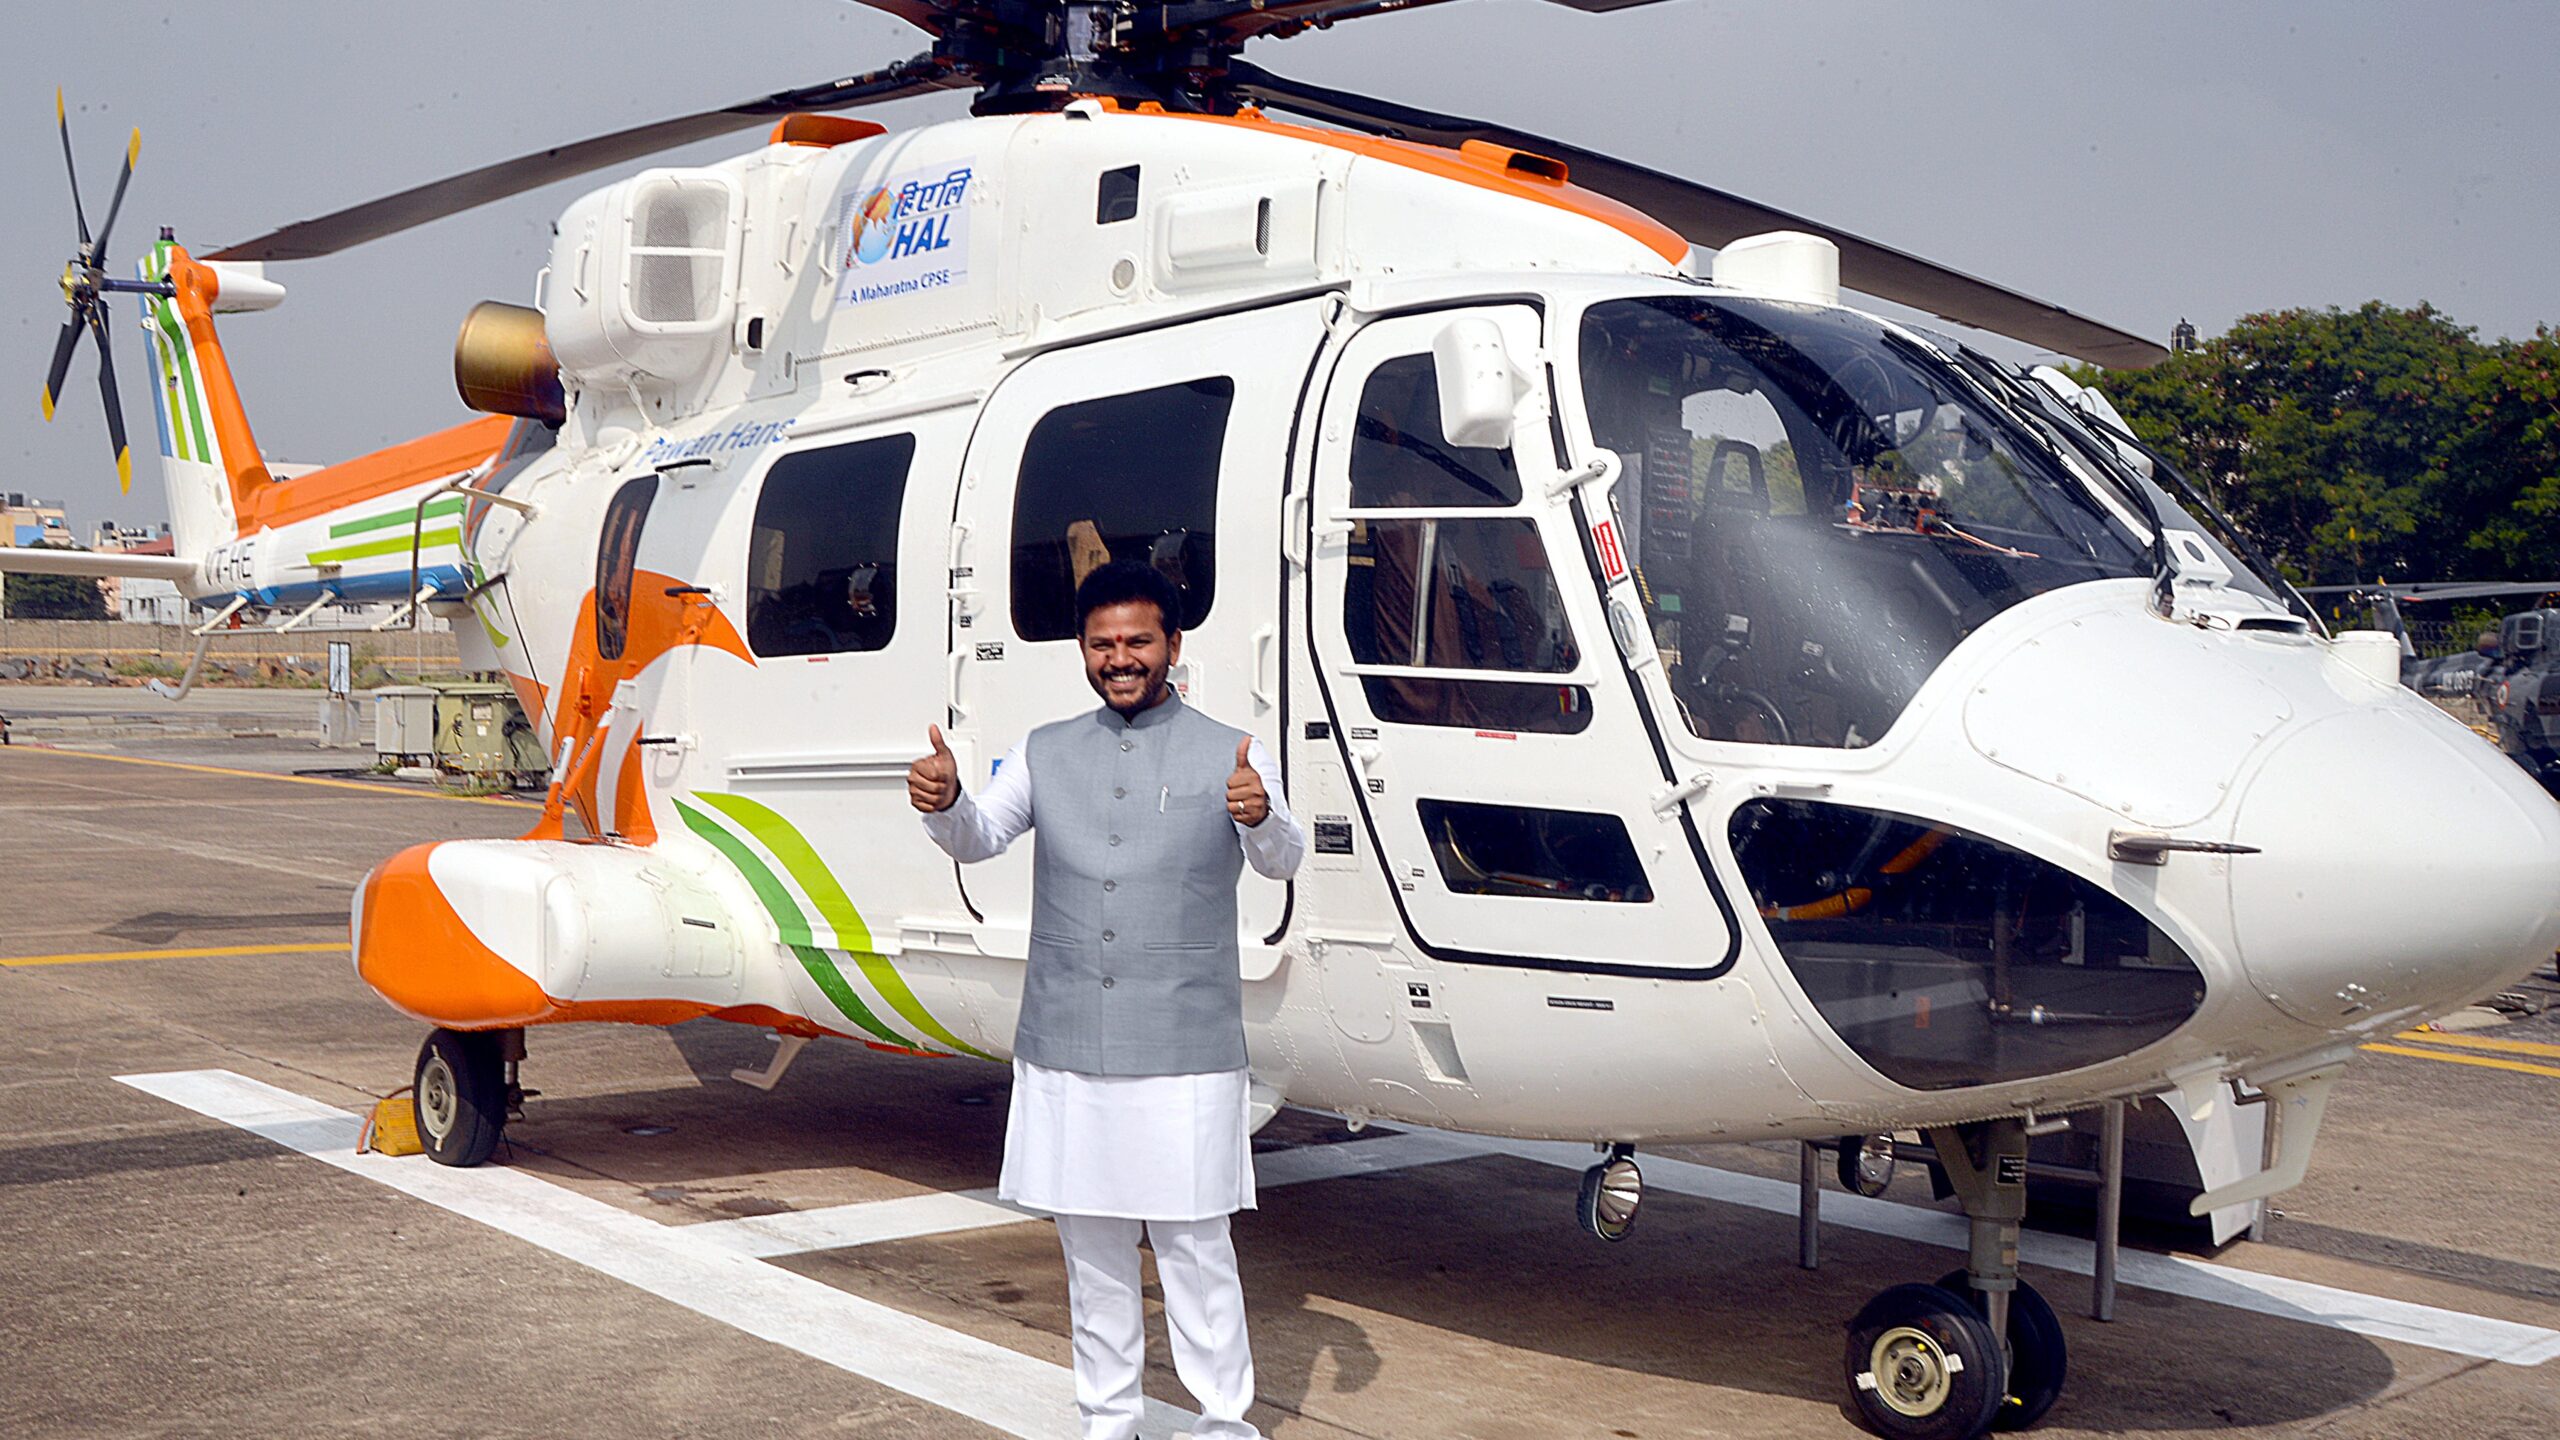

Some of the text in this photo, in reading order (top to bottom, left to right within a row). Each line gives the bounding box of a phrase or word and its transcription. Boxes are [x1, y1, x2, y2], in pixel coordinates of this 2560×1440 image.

[892, 168, 972, 220] हिएलि
[891, 214, 950, 260] HAL
[850, 269, 950, 304] A Maharatna CPSE
